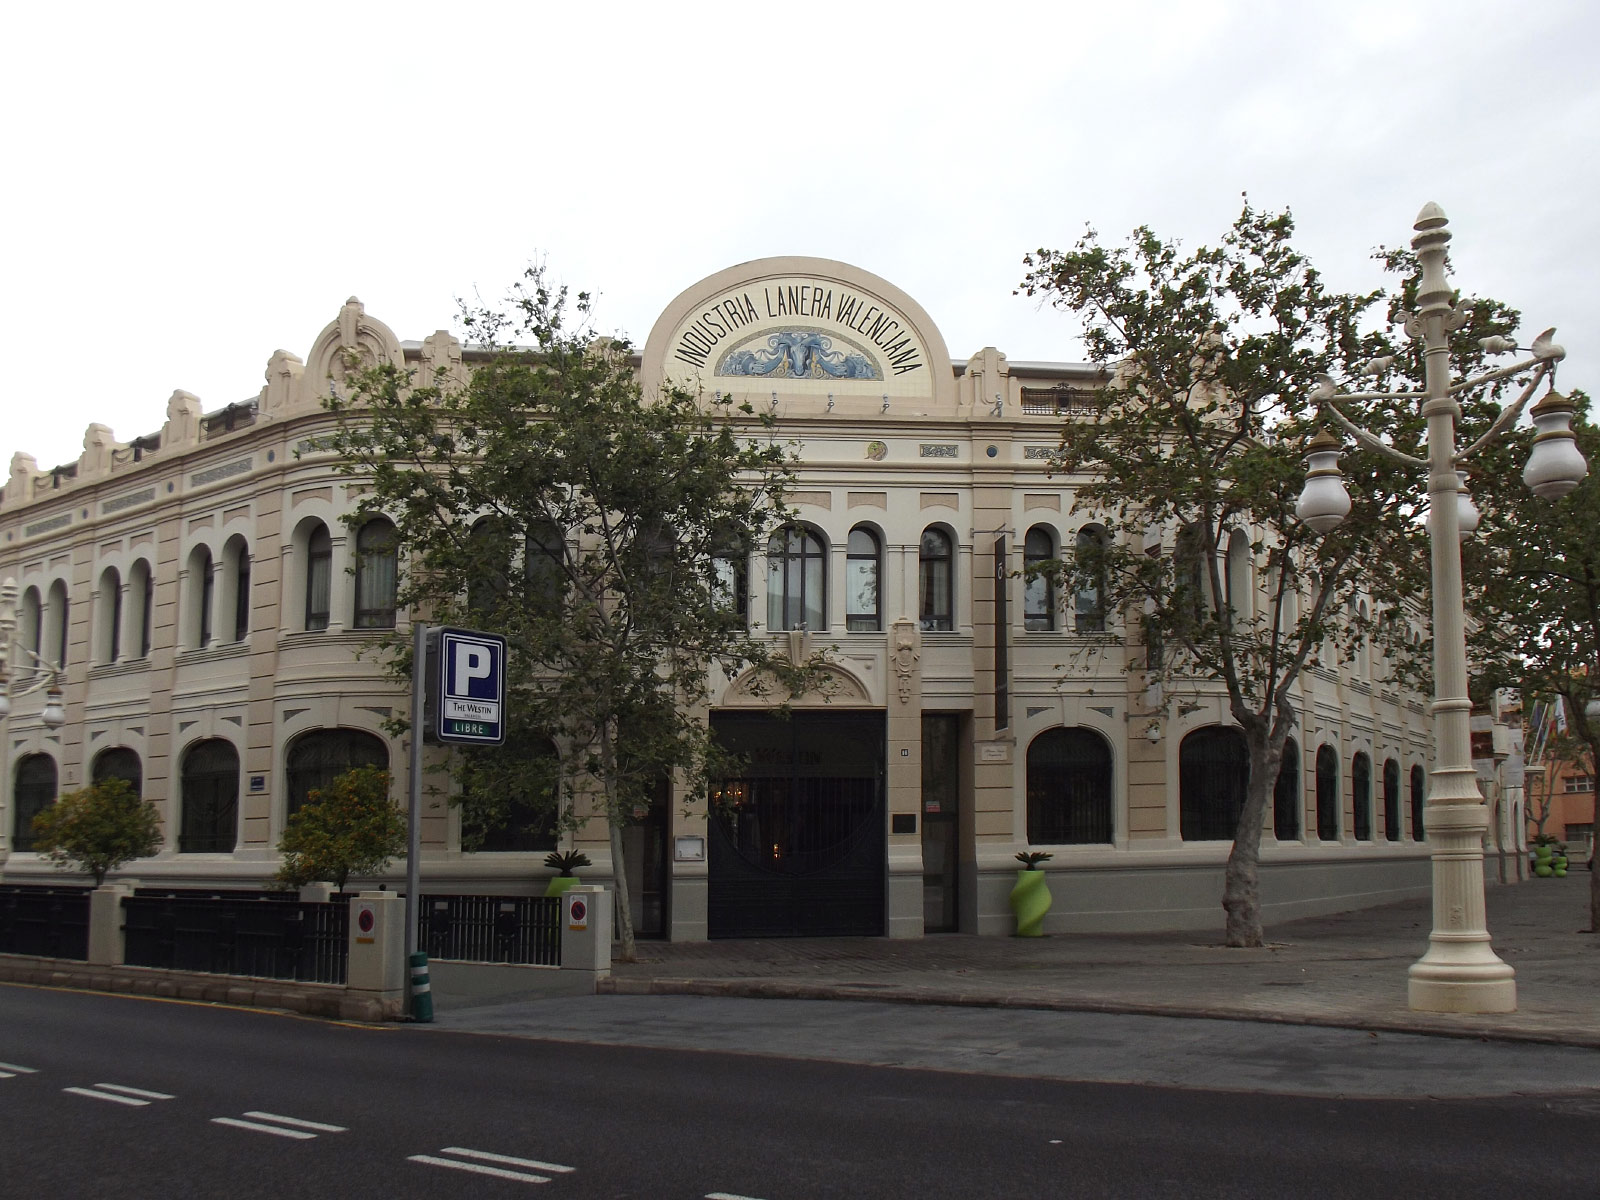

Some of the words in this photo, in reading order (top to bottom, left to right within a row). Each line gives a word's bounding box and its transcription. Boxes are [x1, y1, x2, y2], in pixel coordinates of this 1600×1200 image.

[674, 292, 760, 369] INDUSTRIA
[764, 285, 832, 320] LANERA
[836, 292, 923, 376] VALENCIANA
[454, 642, 491, 696] P
[466, 703, 492, 715] WESTIN
[455, 722, 484, 734] LIBRE
